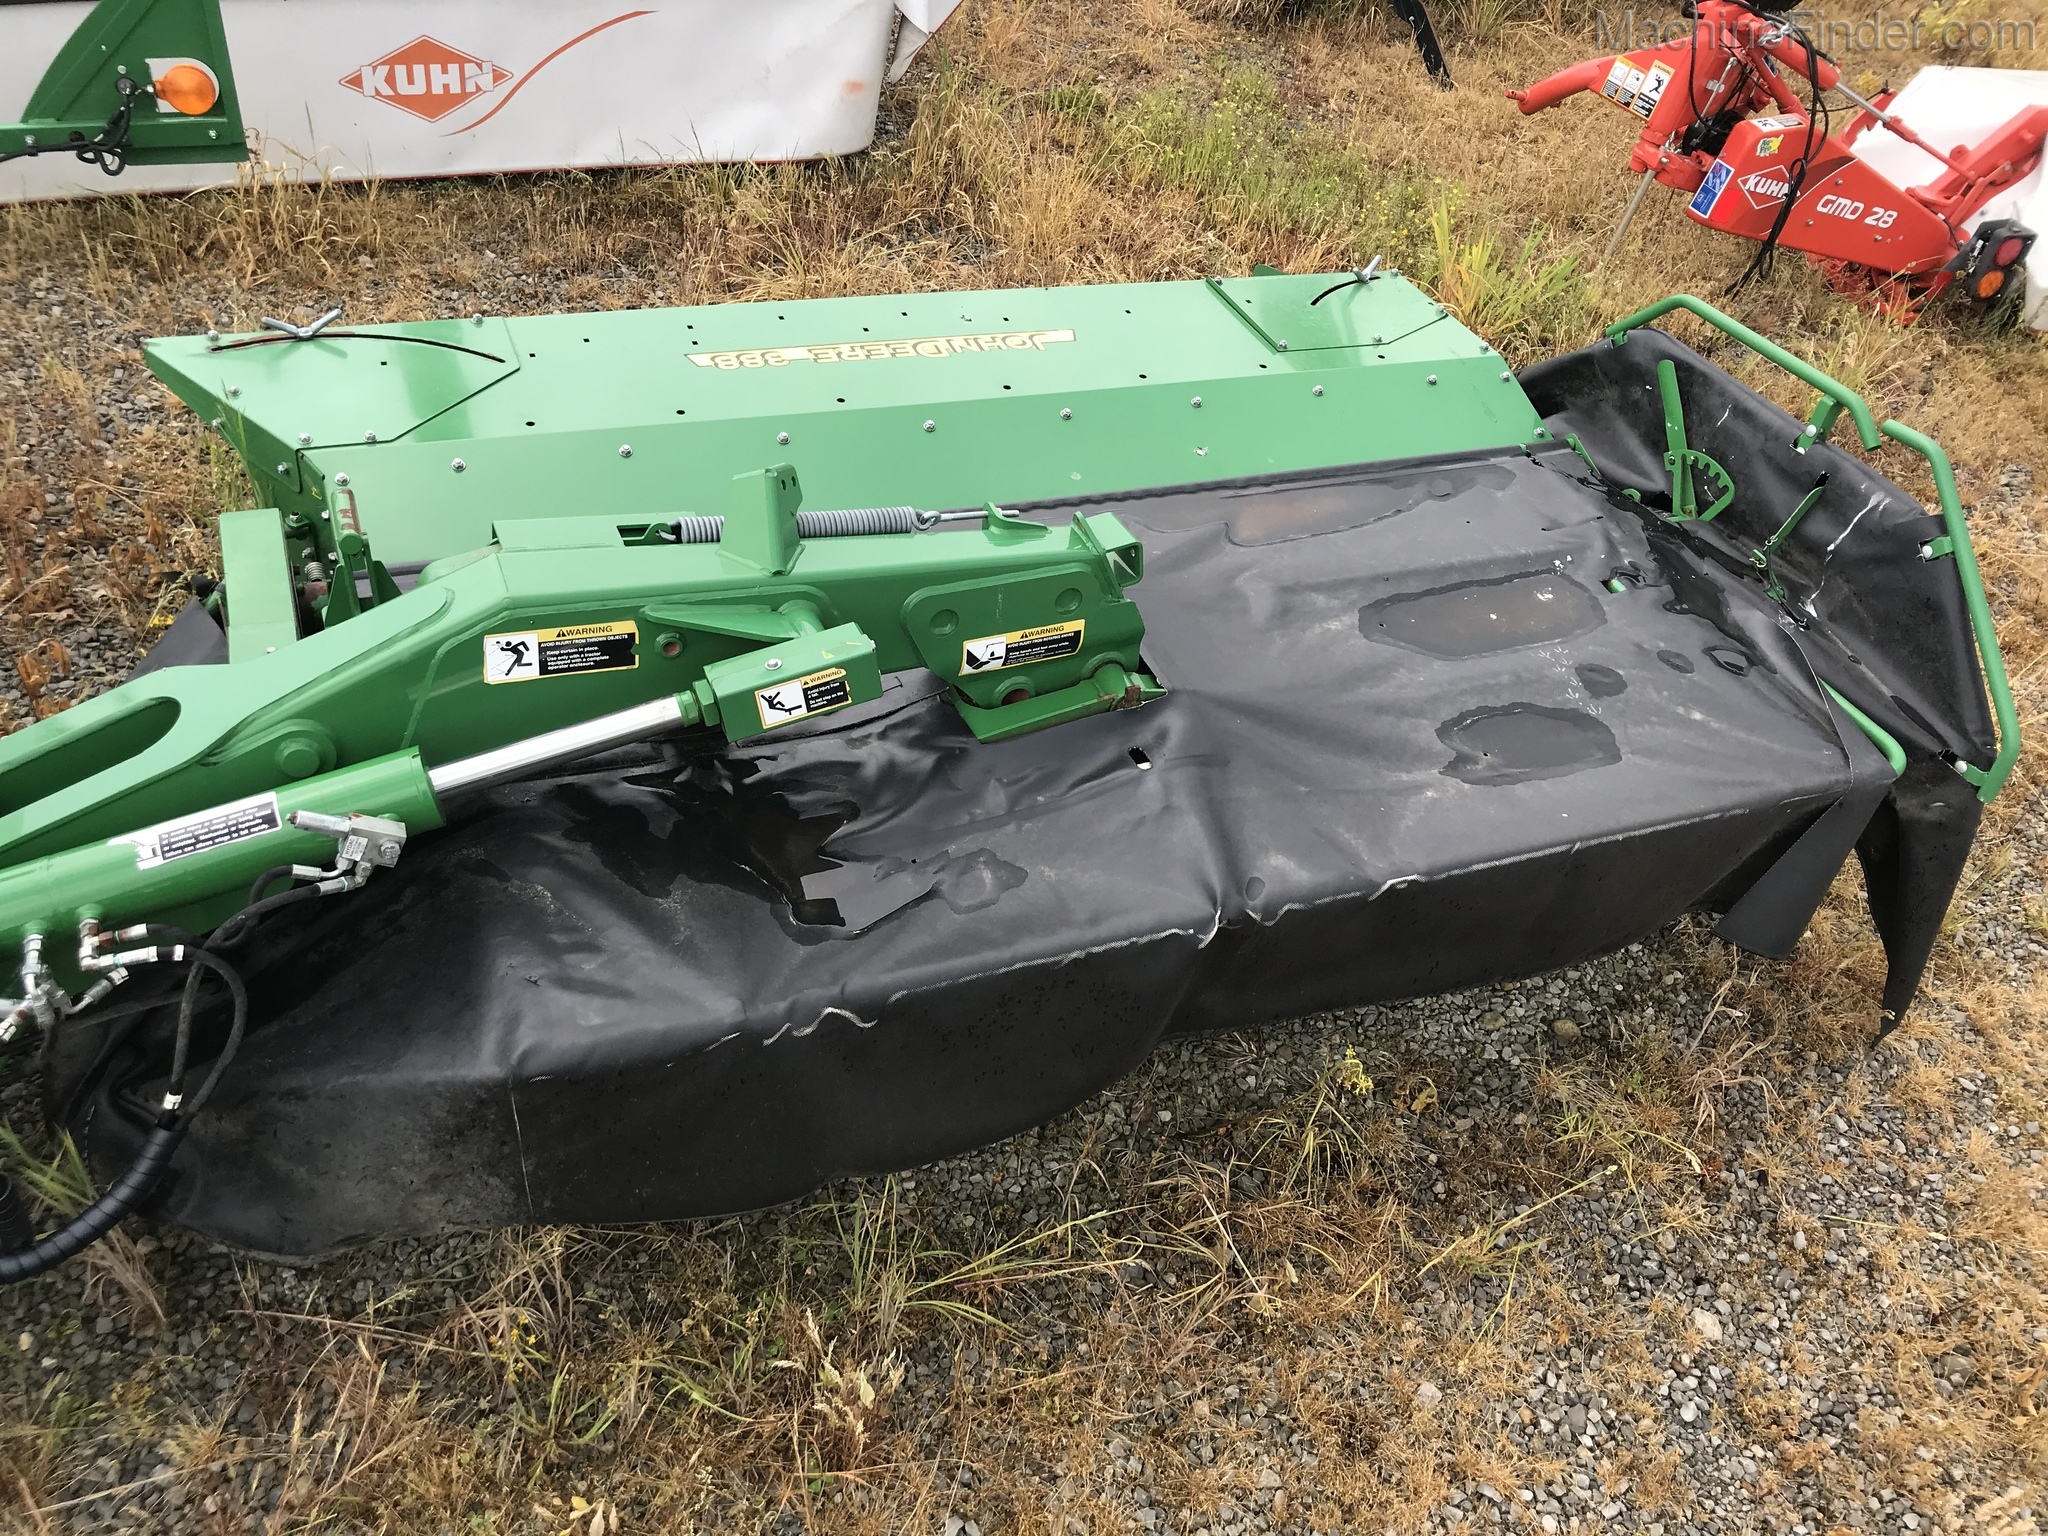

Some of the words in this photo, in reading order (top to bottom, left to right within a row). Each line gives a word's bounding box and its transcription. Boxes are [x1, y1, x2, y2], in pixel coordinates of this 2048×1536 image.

[361, 61, 494, 98] KUHN
[1816, 194, 1865, 220] GMD
[1864, 206, 1898, 229] 28
[809, 338, 953, 363] DEERE
[945, 332, 1053, 355] JOHN
[711, 350, 791, 370] 388
[565, 626, 612, 636] WARNING
[1028, 625, 1064, 637] WARNING
[810, 670, 842, 682] WARNING
[187, 824, 202, 832] injury
[199, 829, 228, 840] Mechanical
[238, 819, 262, 829] hydraulic
[165, 849, 182, 858] failure
[214, 835, 230, 843] wings
[250, 824, 269, 833] rapidly.
